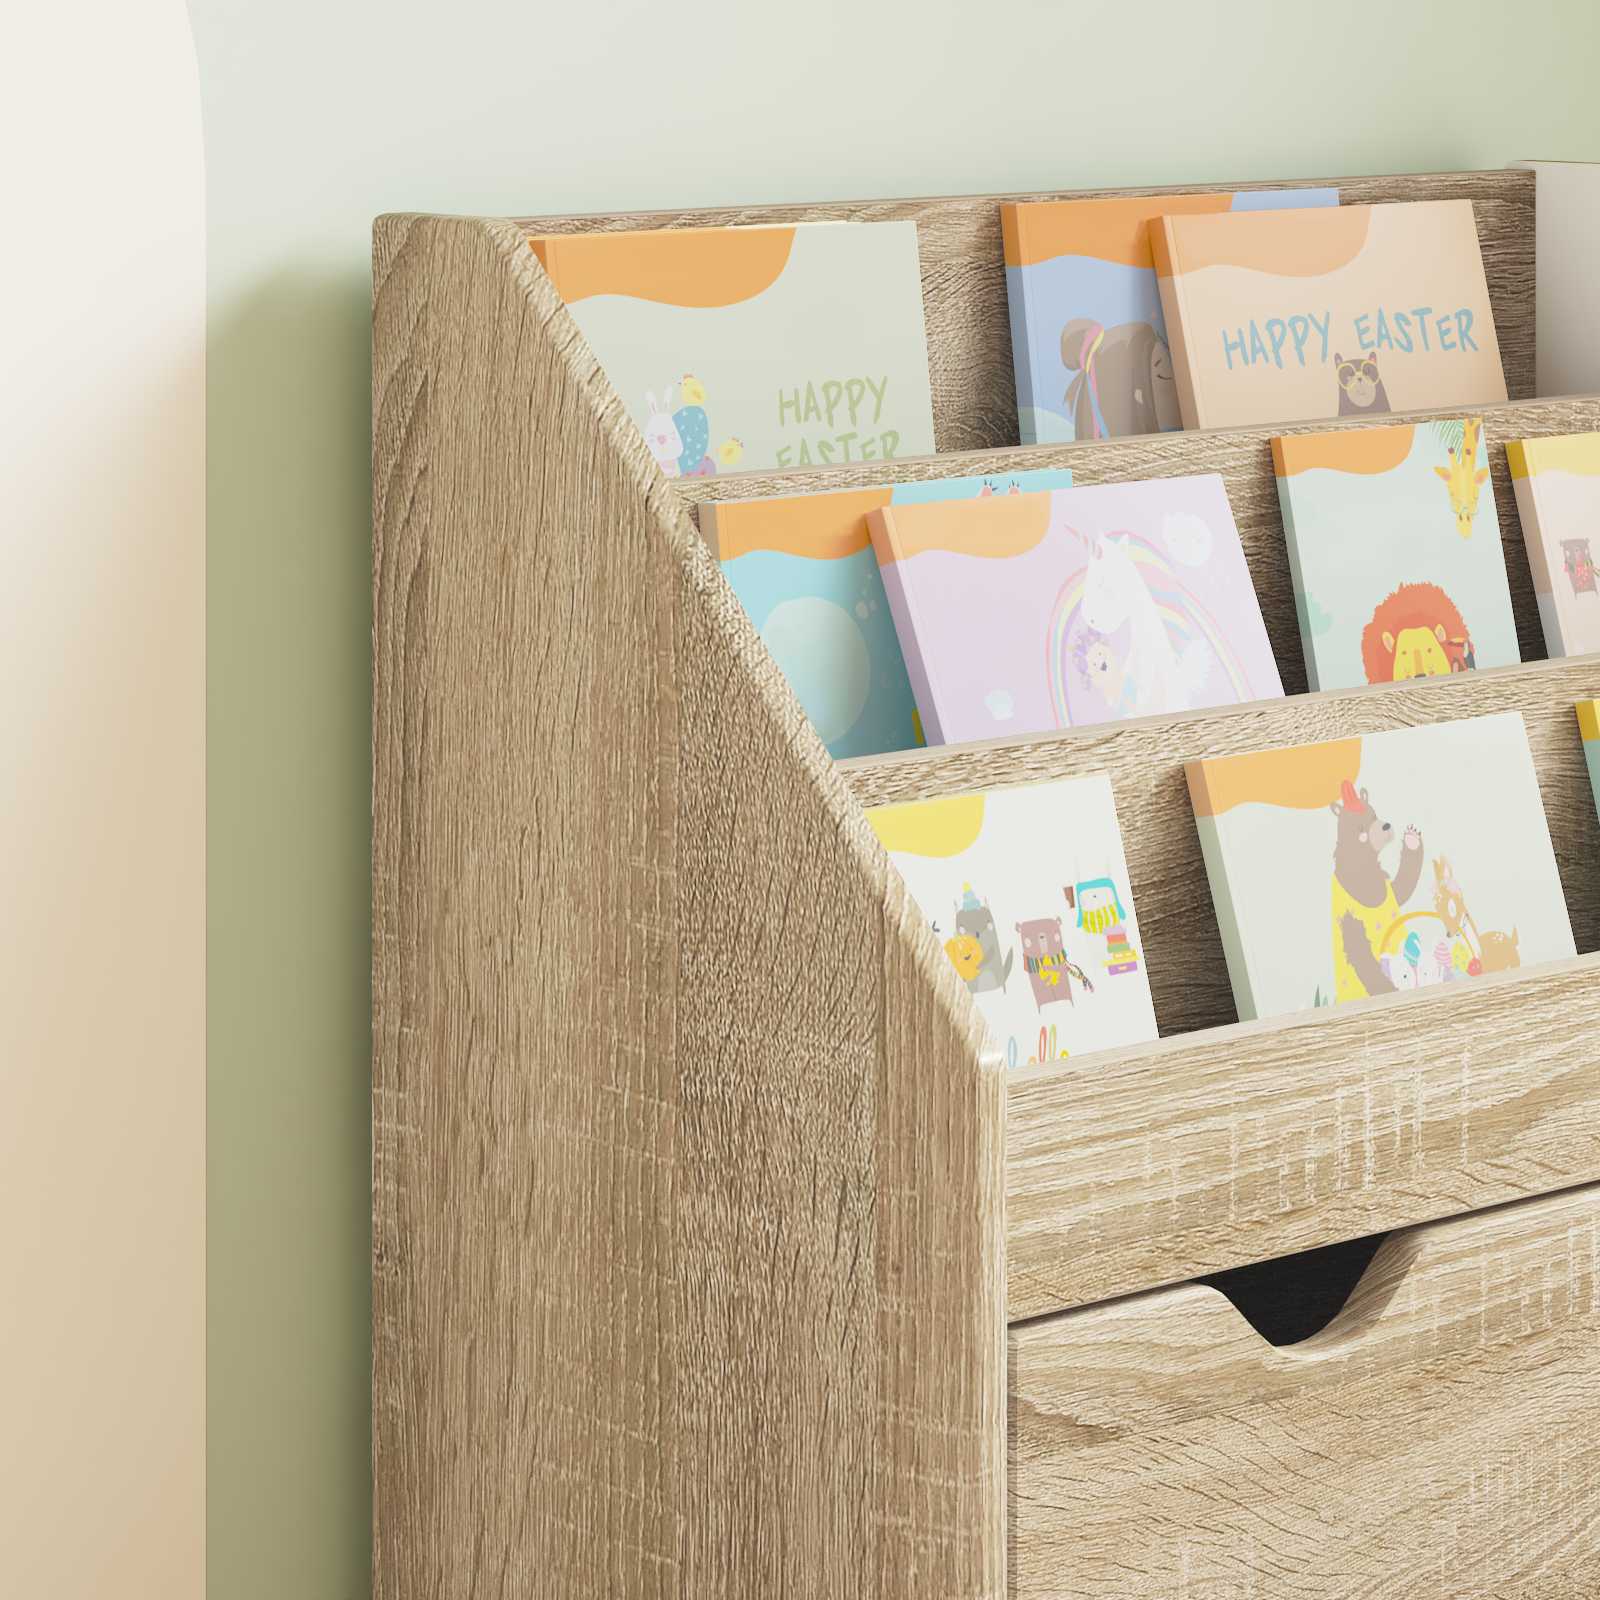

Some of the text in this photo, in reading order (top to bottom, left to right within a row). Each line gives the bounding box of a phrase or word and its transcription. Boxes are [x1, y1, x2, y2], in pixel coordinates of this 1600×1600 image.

[1222, 304, 1479, 370] HAPPY EASTER
[777, 375, 888, 428] HAPPY
